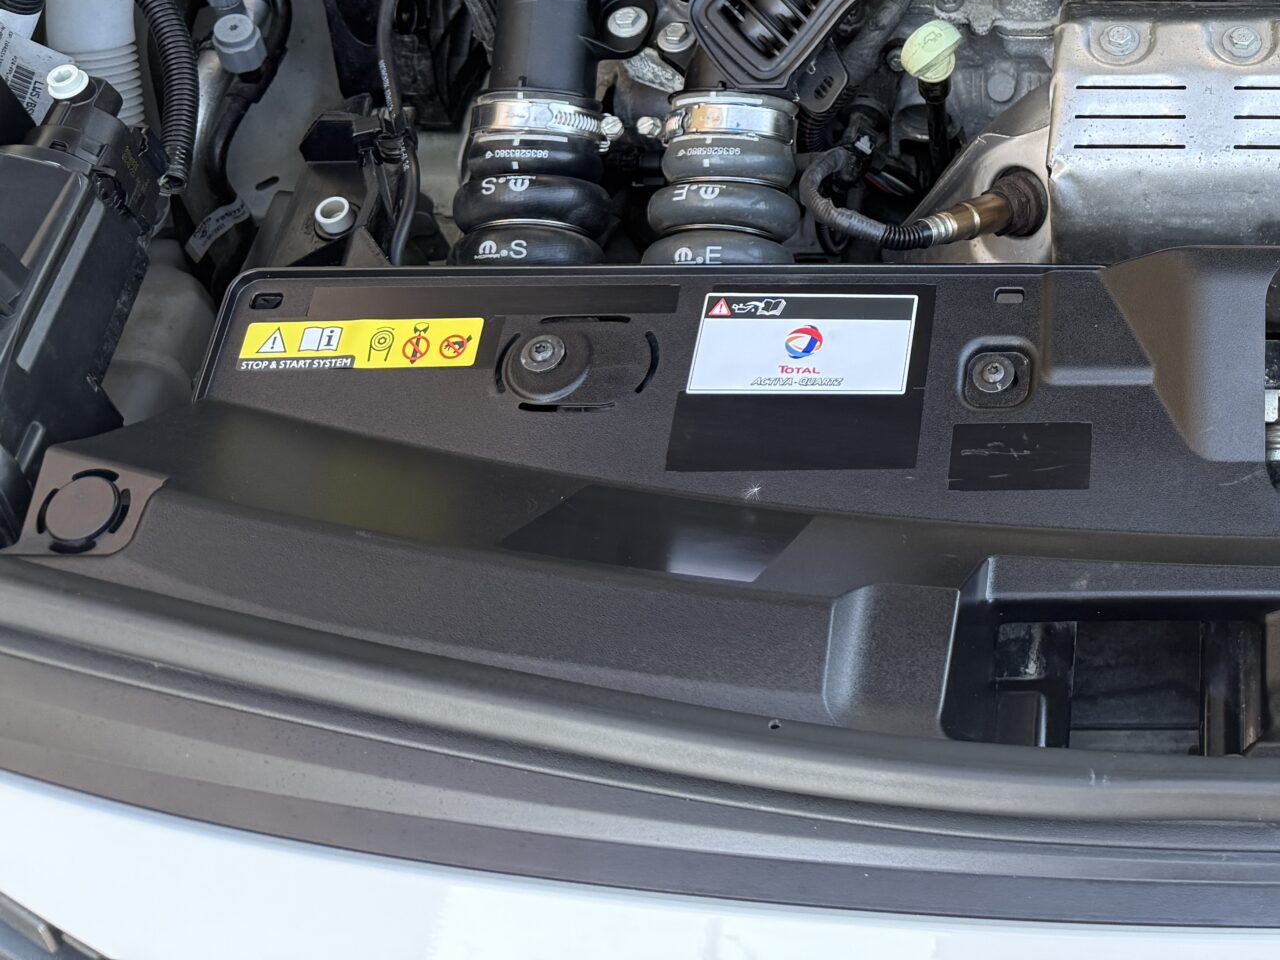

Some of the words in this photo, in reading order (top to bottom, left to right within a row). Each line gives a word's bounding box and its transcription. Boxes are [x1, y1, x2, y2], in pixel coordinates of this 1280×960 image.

[509, 239, 528, 259] S
[705, 246, 723, 264] E
[241, 360, 268, 370] STOP
[269, 360, 277, 369] &
[279, 359, 311, 369] START
[312, 358, 352, 368] SYSTEM
[778, 365, 820, 374] TOTAL
